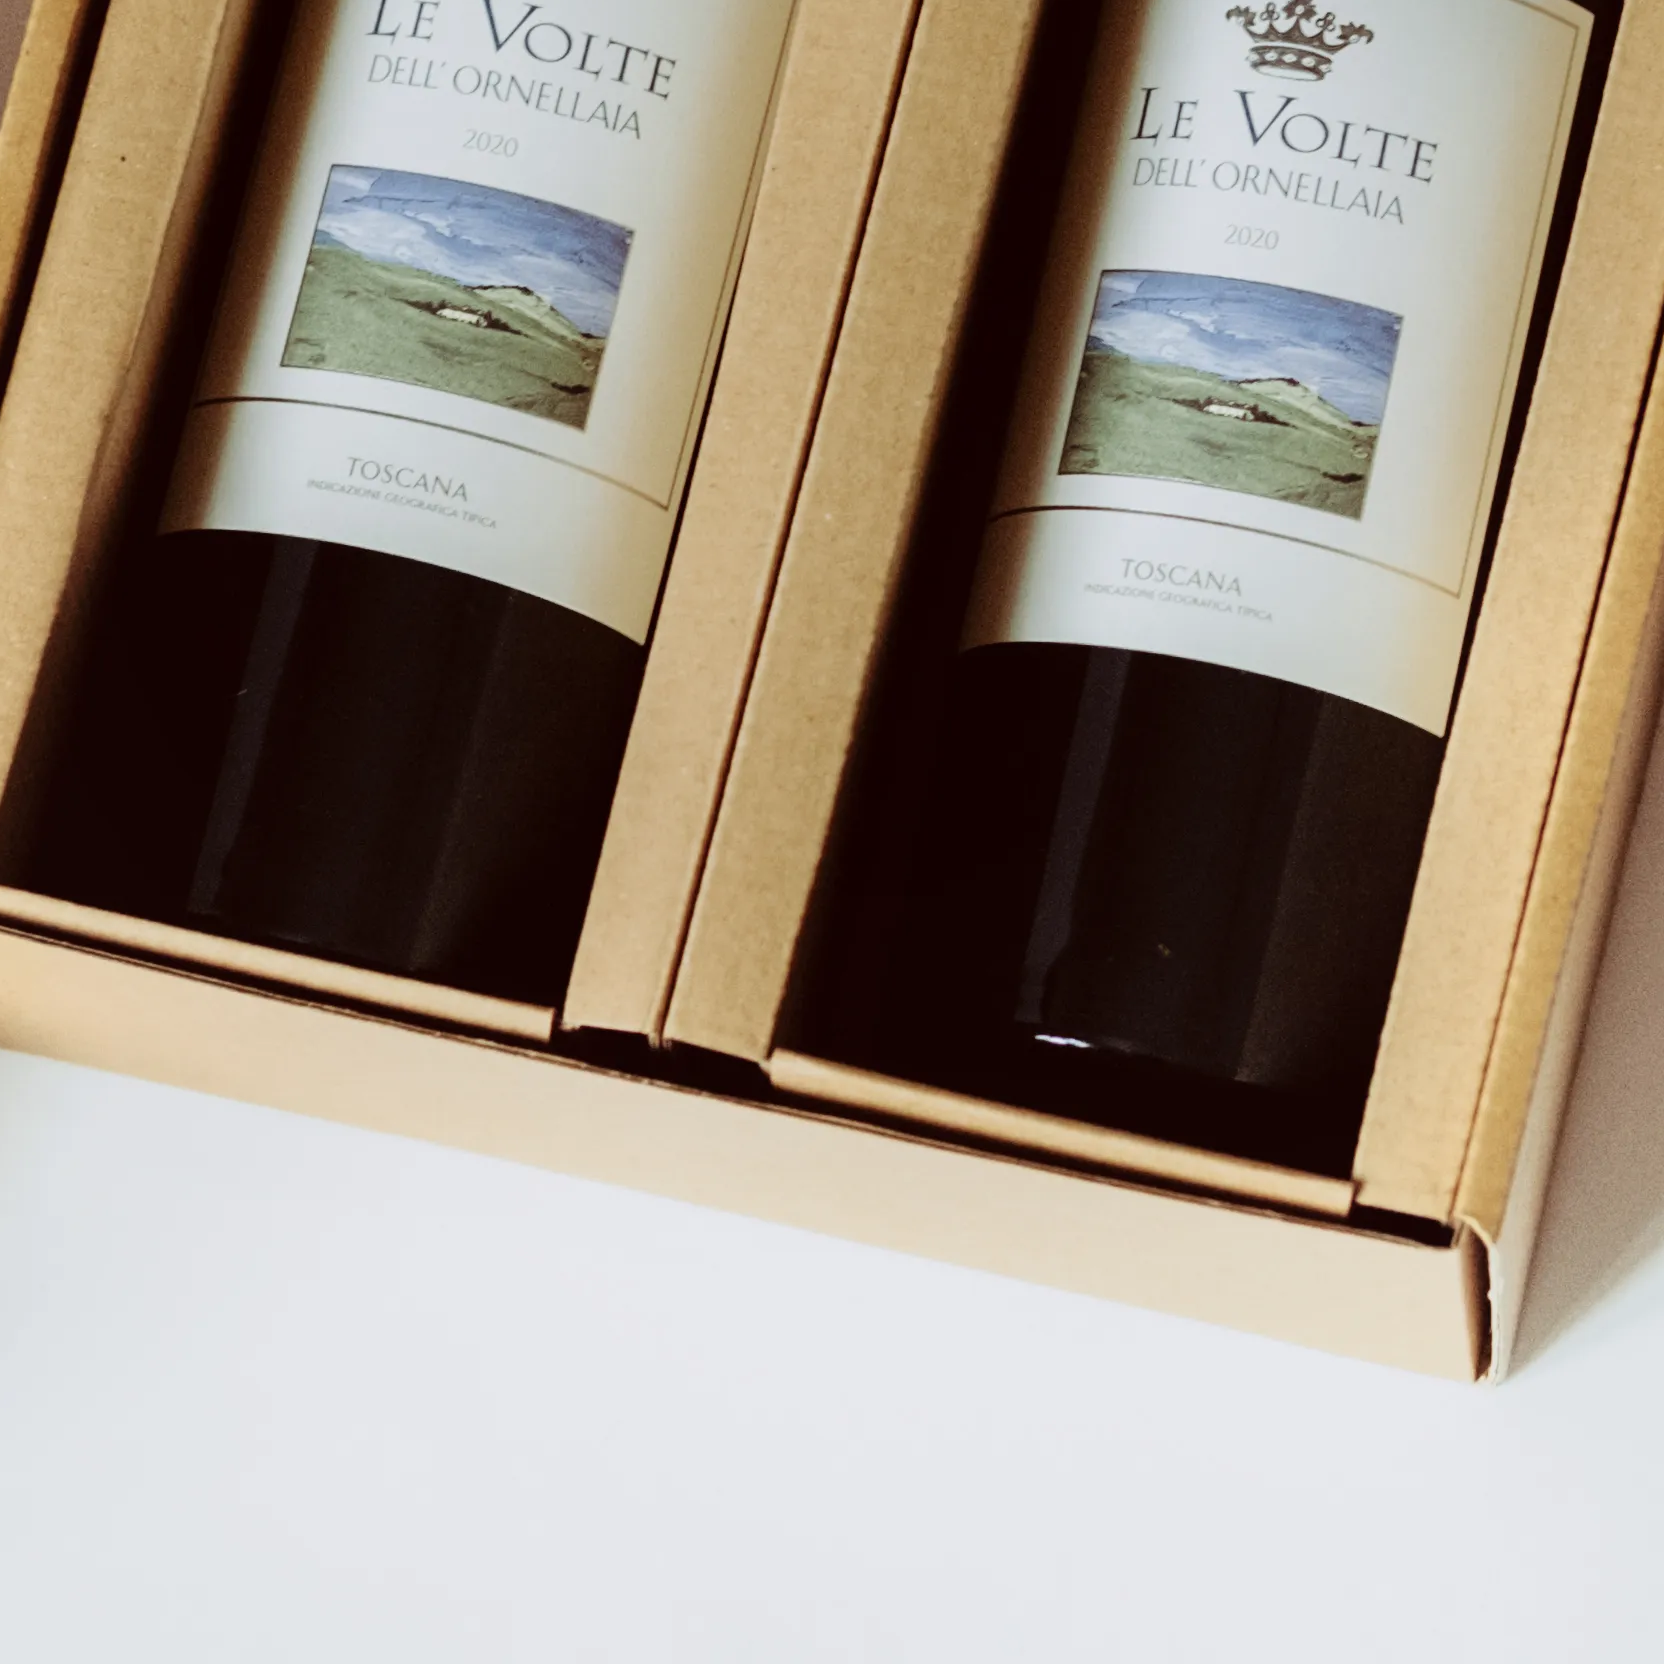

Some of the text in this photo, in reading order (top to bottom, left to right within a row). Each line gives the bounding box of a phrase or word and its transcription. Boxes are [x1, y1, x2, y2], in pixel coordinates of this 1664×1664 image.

[462, 128, 519, 159] 2020
[1130, 86, 1438, 184] LE VOLTE
[1224, 223, 1279, 251] 2020
[306, 478, 381, 501] INDICAZIONE
[384, 491, 458, 519] GEOGRAFICA
[346, 456, 469, 503] TOSCANA
[1121, 557, 1243, 597] TOSCANA
